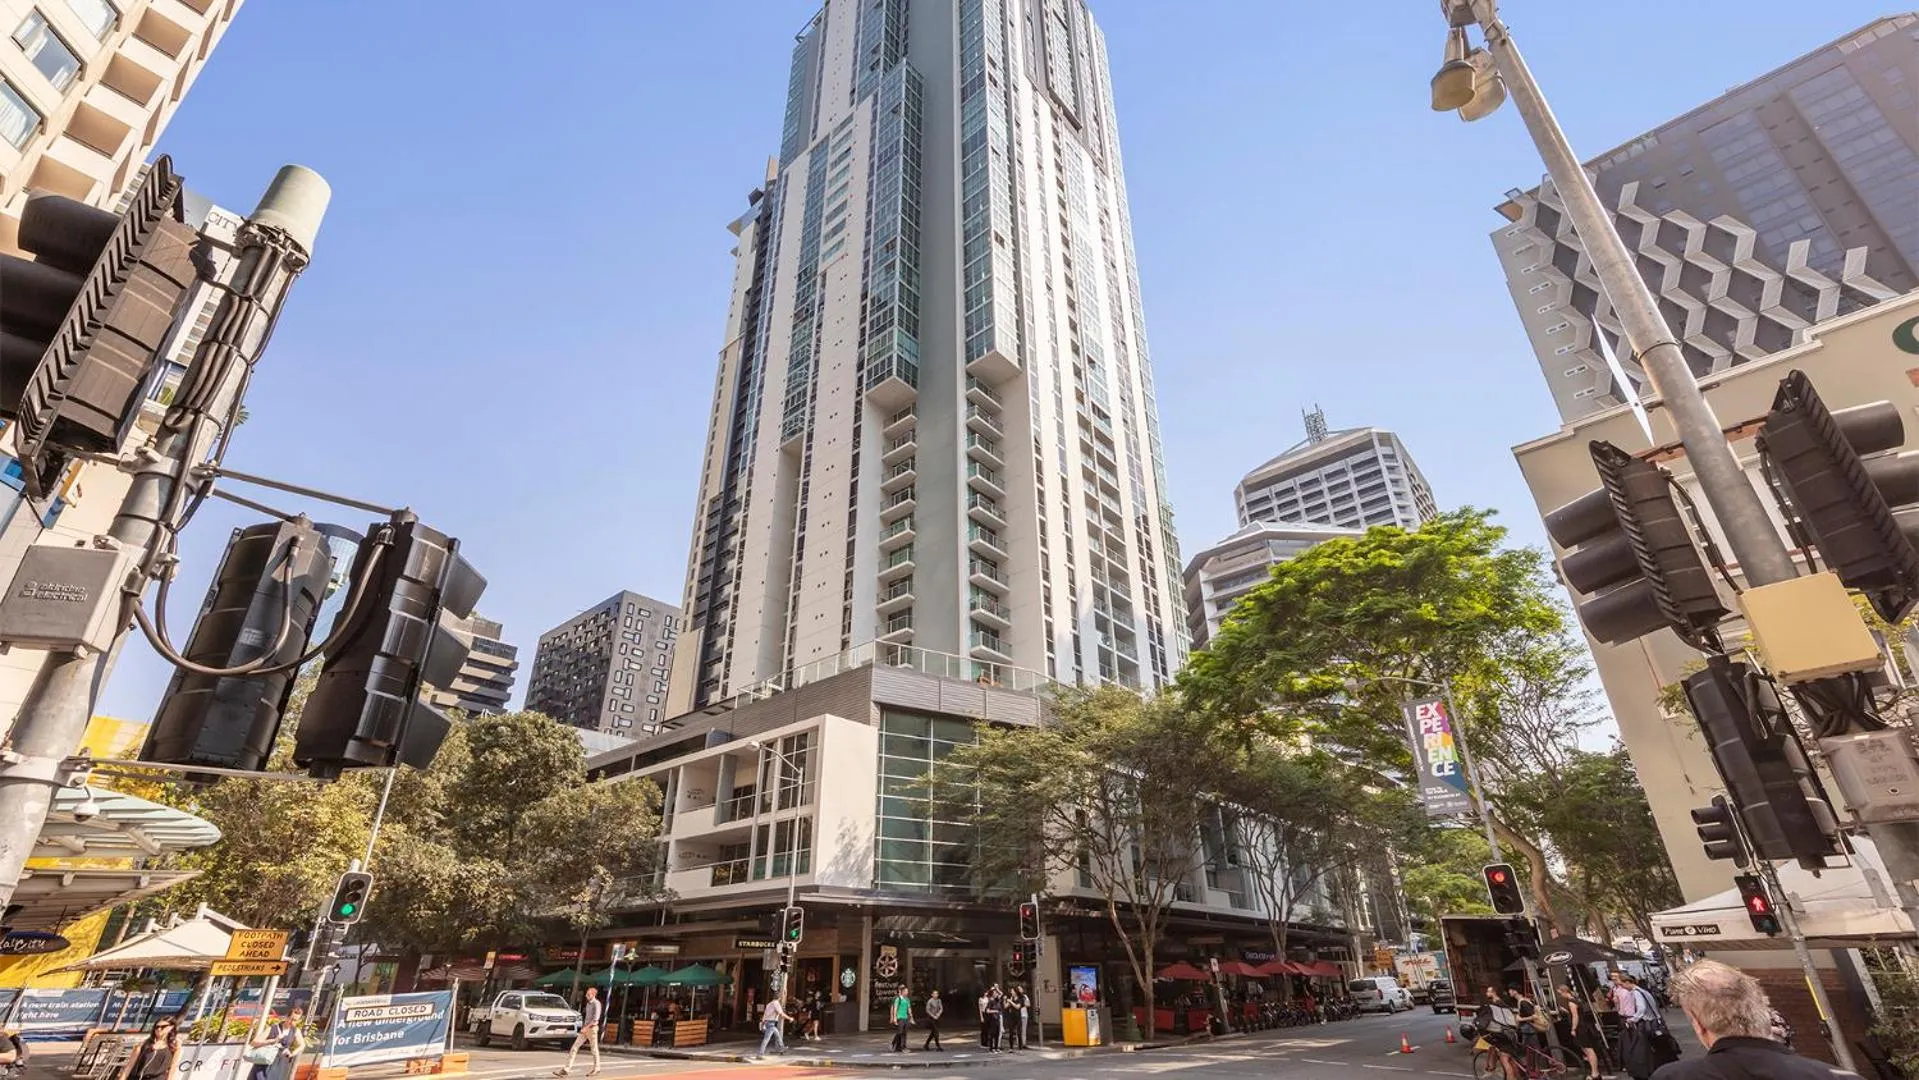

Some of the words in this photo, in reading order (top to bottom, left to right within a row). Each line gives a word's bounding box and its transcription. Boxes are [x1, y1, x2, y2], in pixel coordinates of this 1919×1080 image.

[239, 932, 283, 940] FOOTPATH
[240, 941, 276, 949] CLOSED
[239, 950, 270, 958] AHEAD
[354, 1009, 383, 1019] ROAD
[388, 1005, 427, 1016] CLOSED
[337, 1018, 346, 1029] A
[333, 1035, 350, 1046] for
[353, 1030, 405, 1045] Brisbane
[178, 1059, 240, 1073] CRFT
